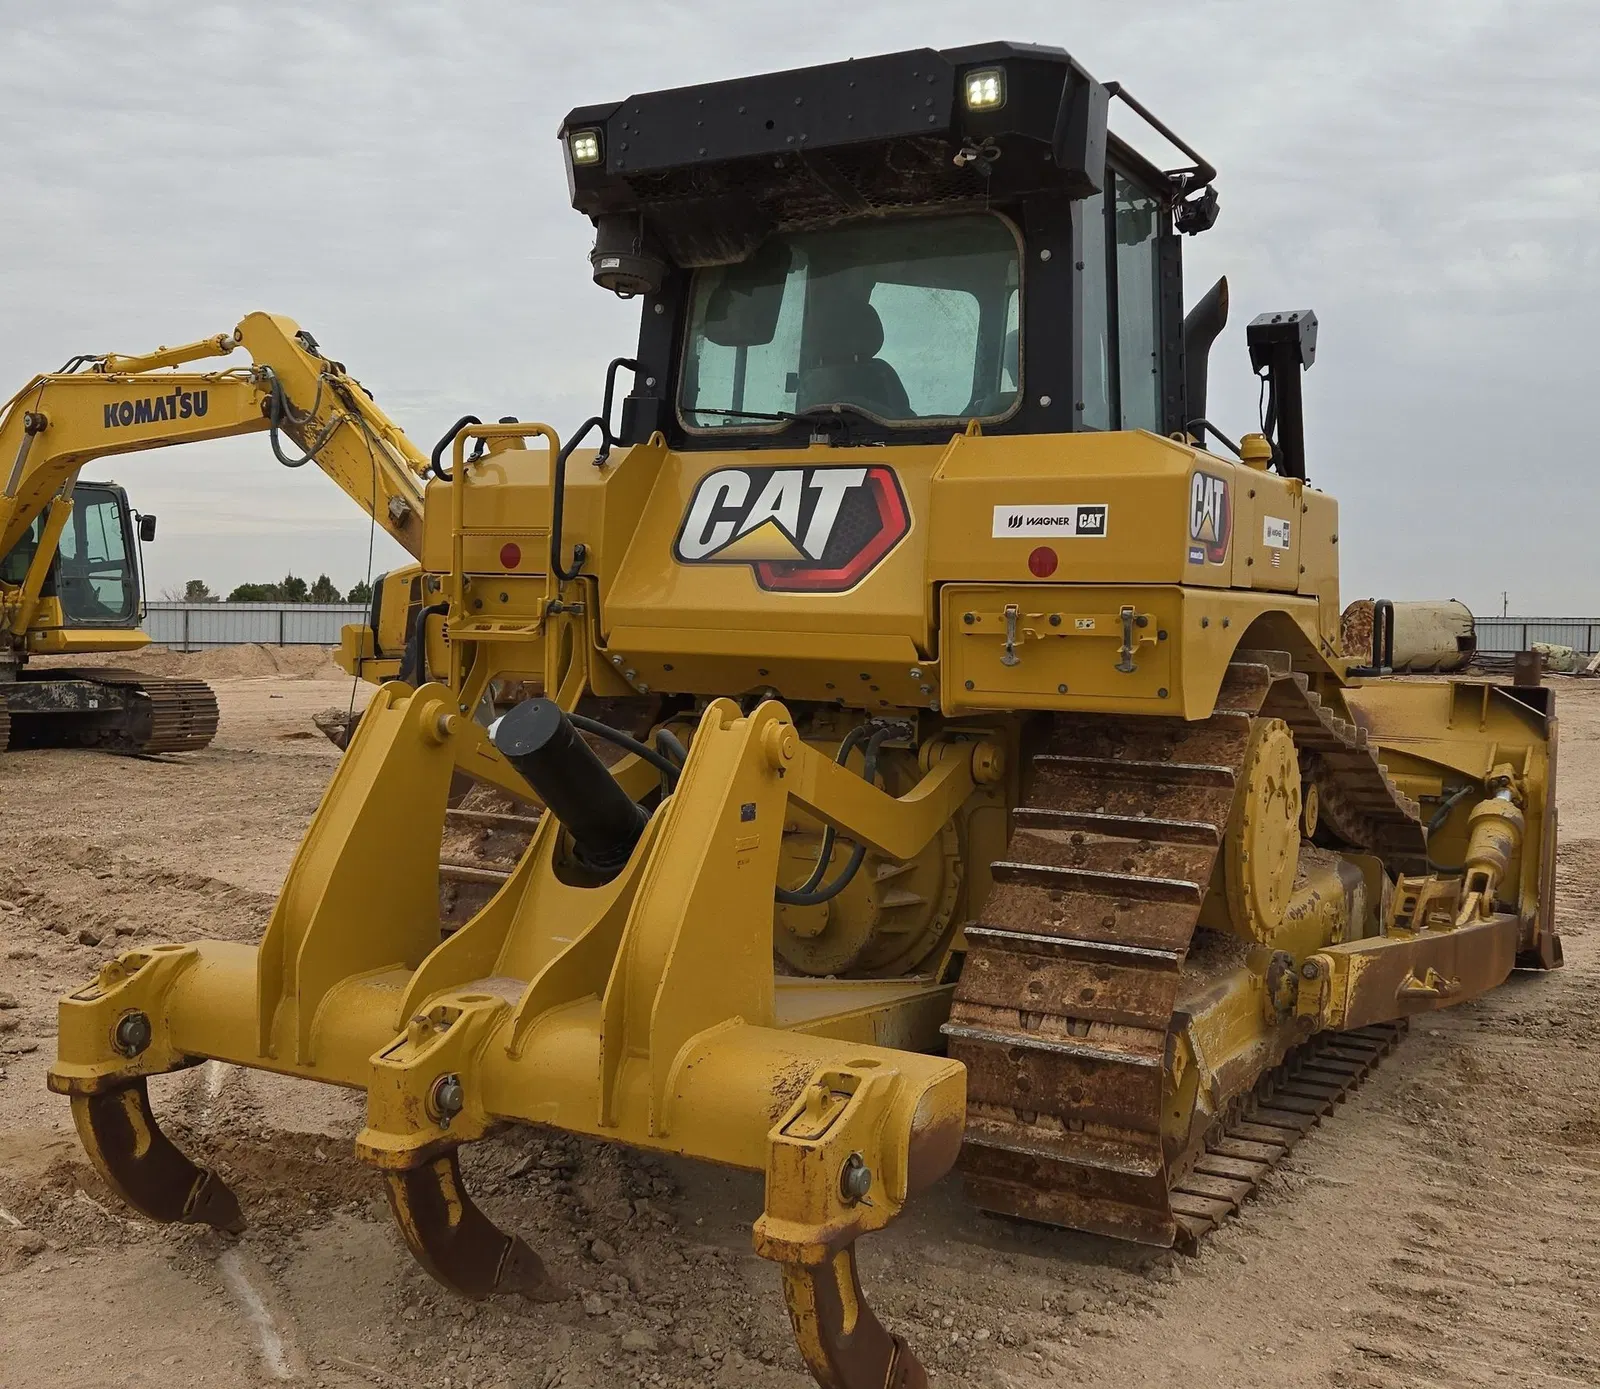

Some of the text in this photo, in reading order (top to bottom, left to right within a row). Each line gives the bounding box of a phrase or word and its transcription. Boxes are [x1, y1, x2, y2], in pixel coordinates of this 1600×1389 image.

[104, 386, 208, 428] KOMATSU
[679, 468, 868, 560] CAT
[1026, 513, 1105, 528] WAGNER CAT
[1191, 472, 1225, 542] CAT
